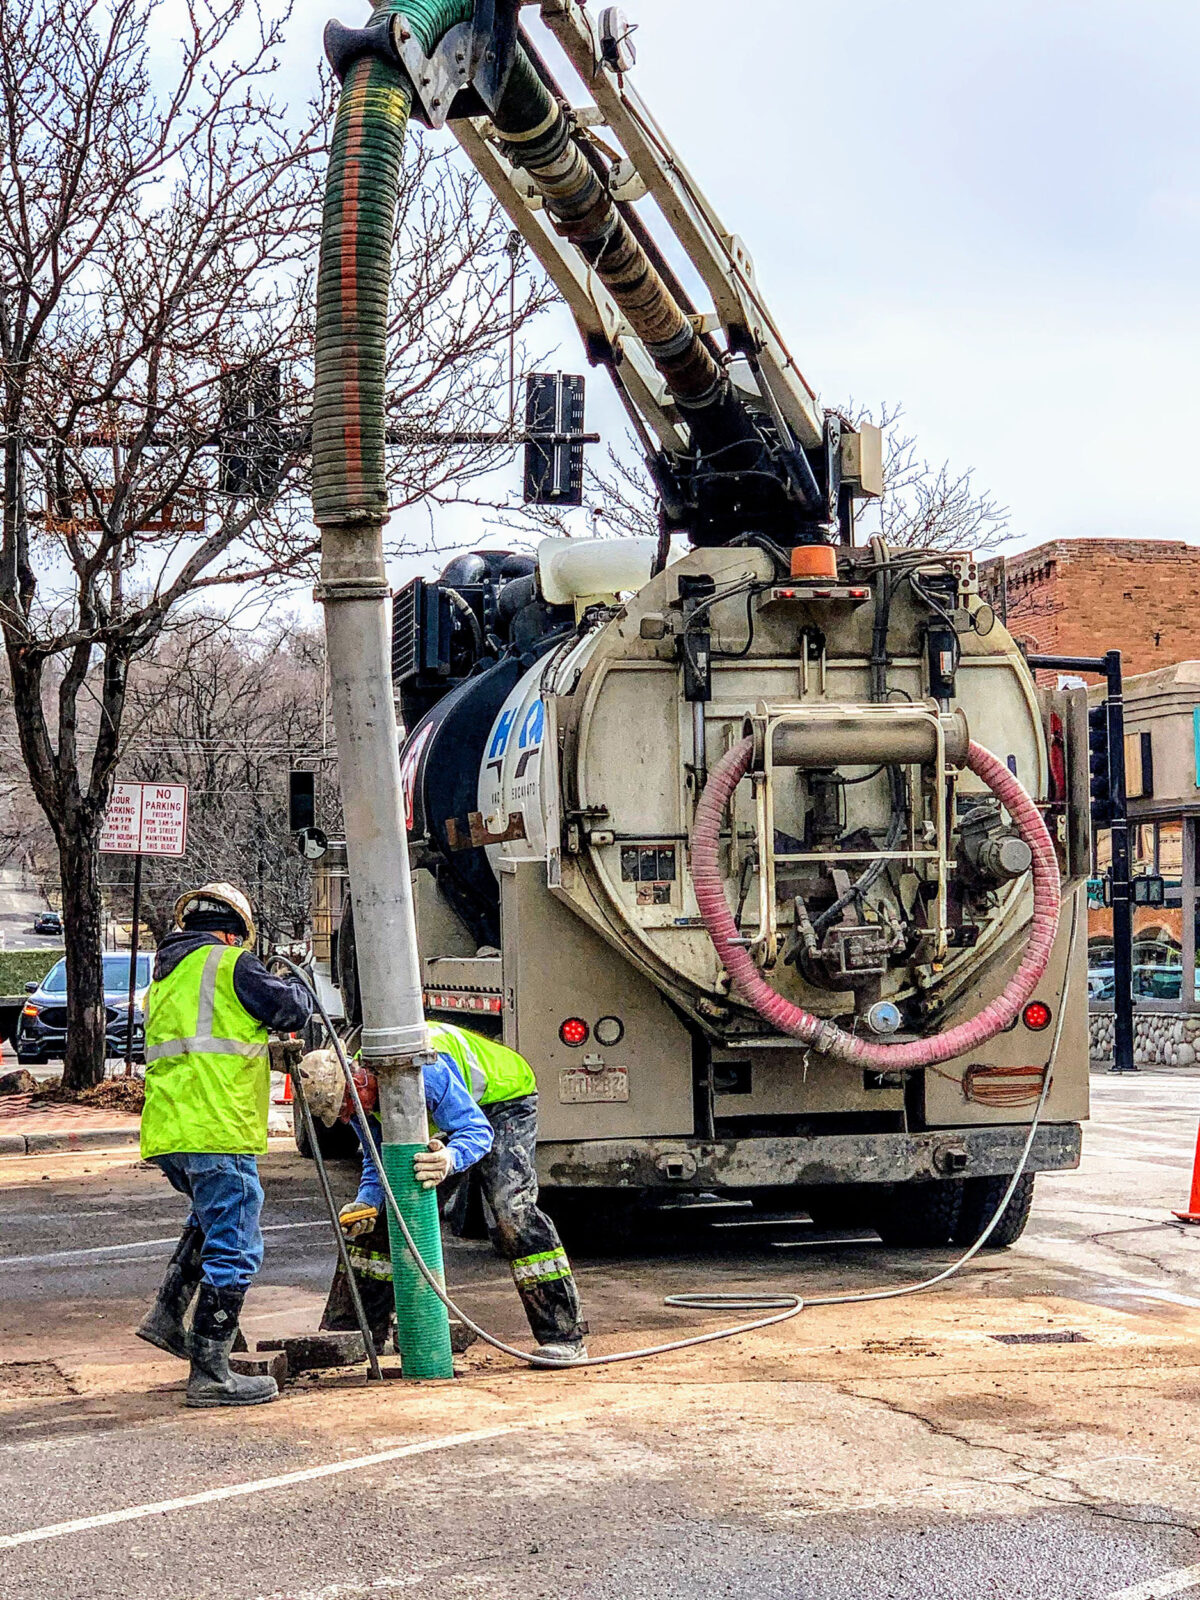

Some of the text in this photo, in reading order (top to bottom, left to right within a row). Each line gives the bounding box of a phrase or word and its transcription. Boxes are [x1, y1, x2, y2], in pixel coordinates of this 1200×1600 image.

[118, 786, 124, 794] 2
[156, 789, 171, 799] NO
[110, 796, 130, 804] HOUR
[145, 801, 181, 811] PARKING
[107, 806, 135, 815] ARKING
[116, 833, 138, 841] HOLIDAYS
[145, 835, 178, 843] MAINTENANCE
